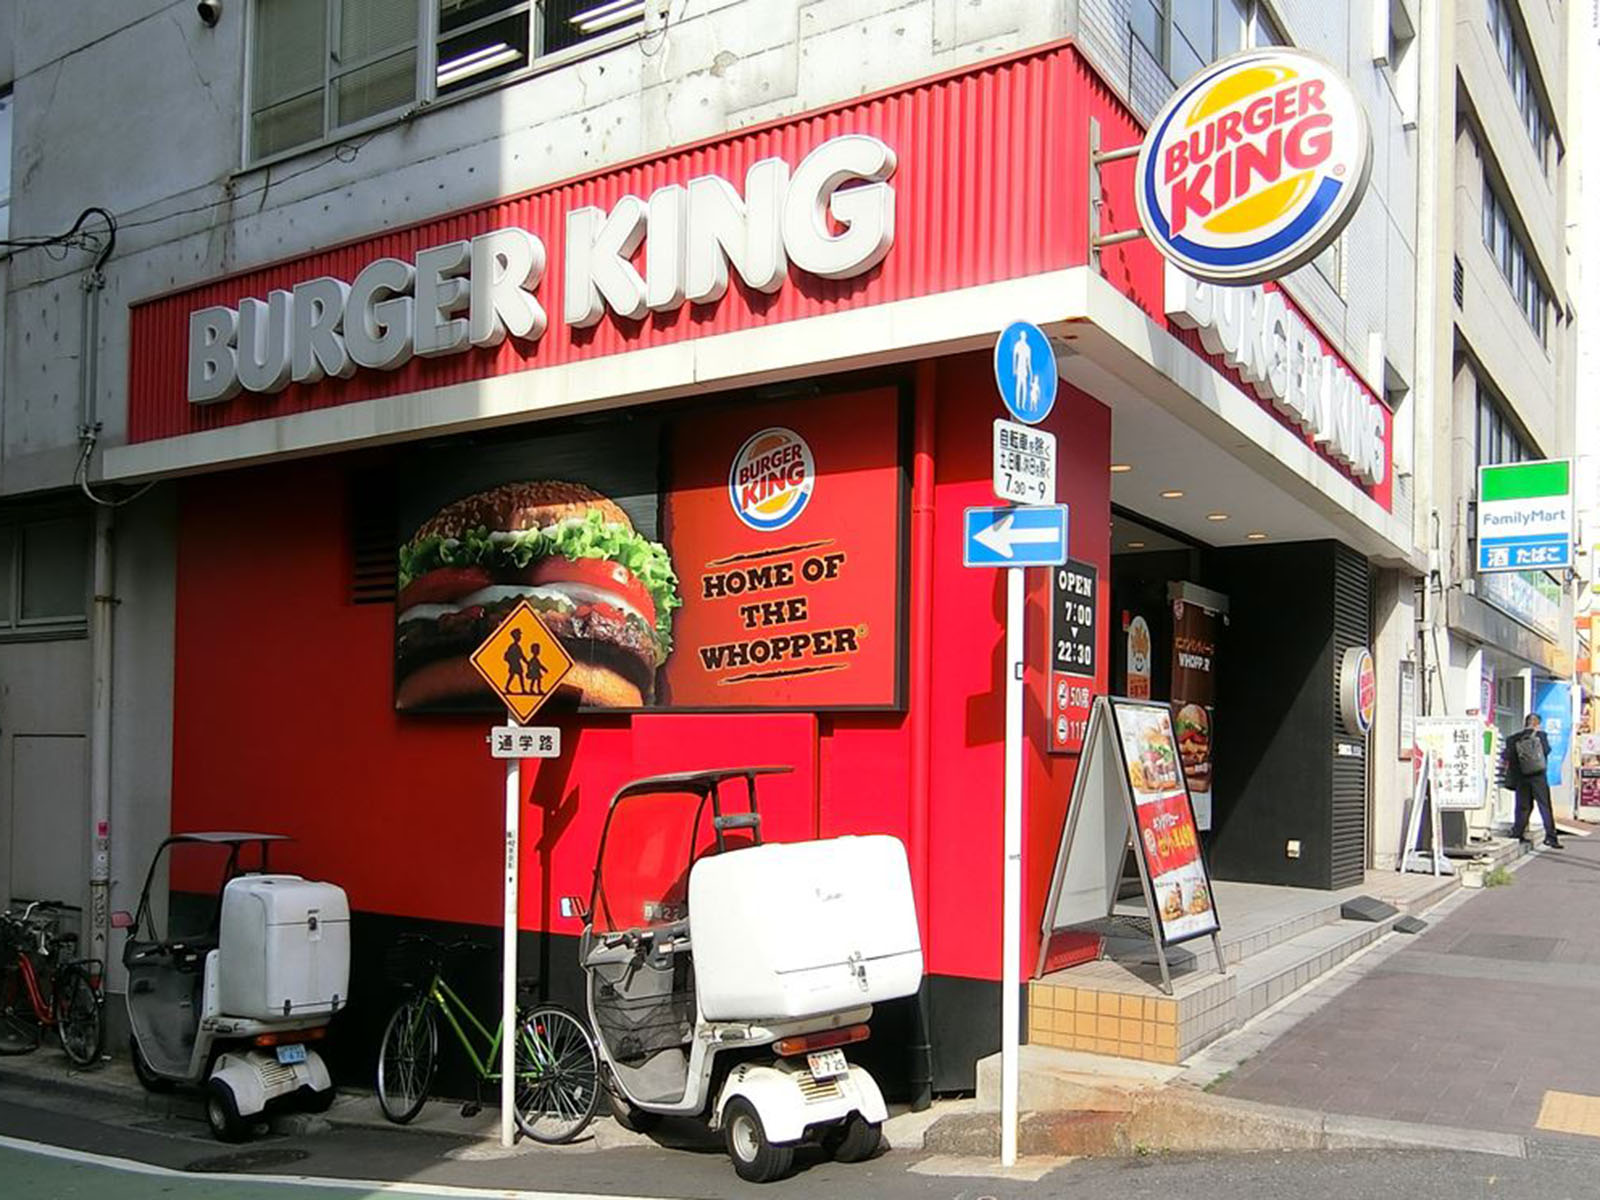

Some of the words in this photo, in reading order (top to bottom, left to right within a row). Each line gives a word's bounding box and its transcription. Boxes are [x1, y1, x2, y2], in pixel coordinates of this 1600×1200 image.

[1164, 79, 1326, 186] BURGER
[1169, 113, 1333, 238] KING
[188, 227, 547, 404] BURGER
[564, 134, 898, 328] KING
[739, 443, 802, 486] BURGER
[741, 460, 806, 511] KING
[1483, 509, 1566, 526] FamilyMart
[702, 562, 794, 599] HOME
[801, 552, 846, 582] OF
[1487, 547, 1510, 567] 酒
[1516, 546, 1561, 565] たばこ
[1058, 570, 1092, 597] OPEN
[740, 597, 808, 628] THE
[1065, 601, 1092, 627] 7:00
[699, 628, 858, 671] WHOPPER
[1057, 640, 1092, 665] 22:30
[497, 734, 553, 752] 通学路
[1453, 728, 1470, 793] 極真空手
